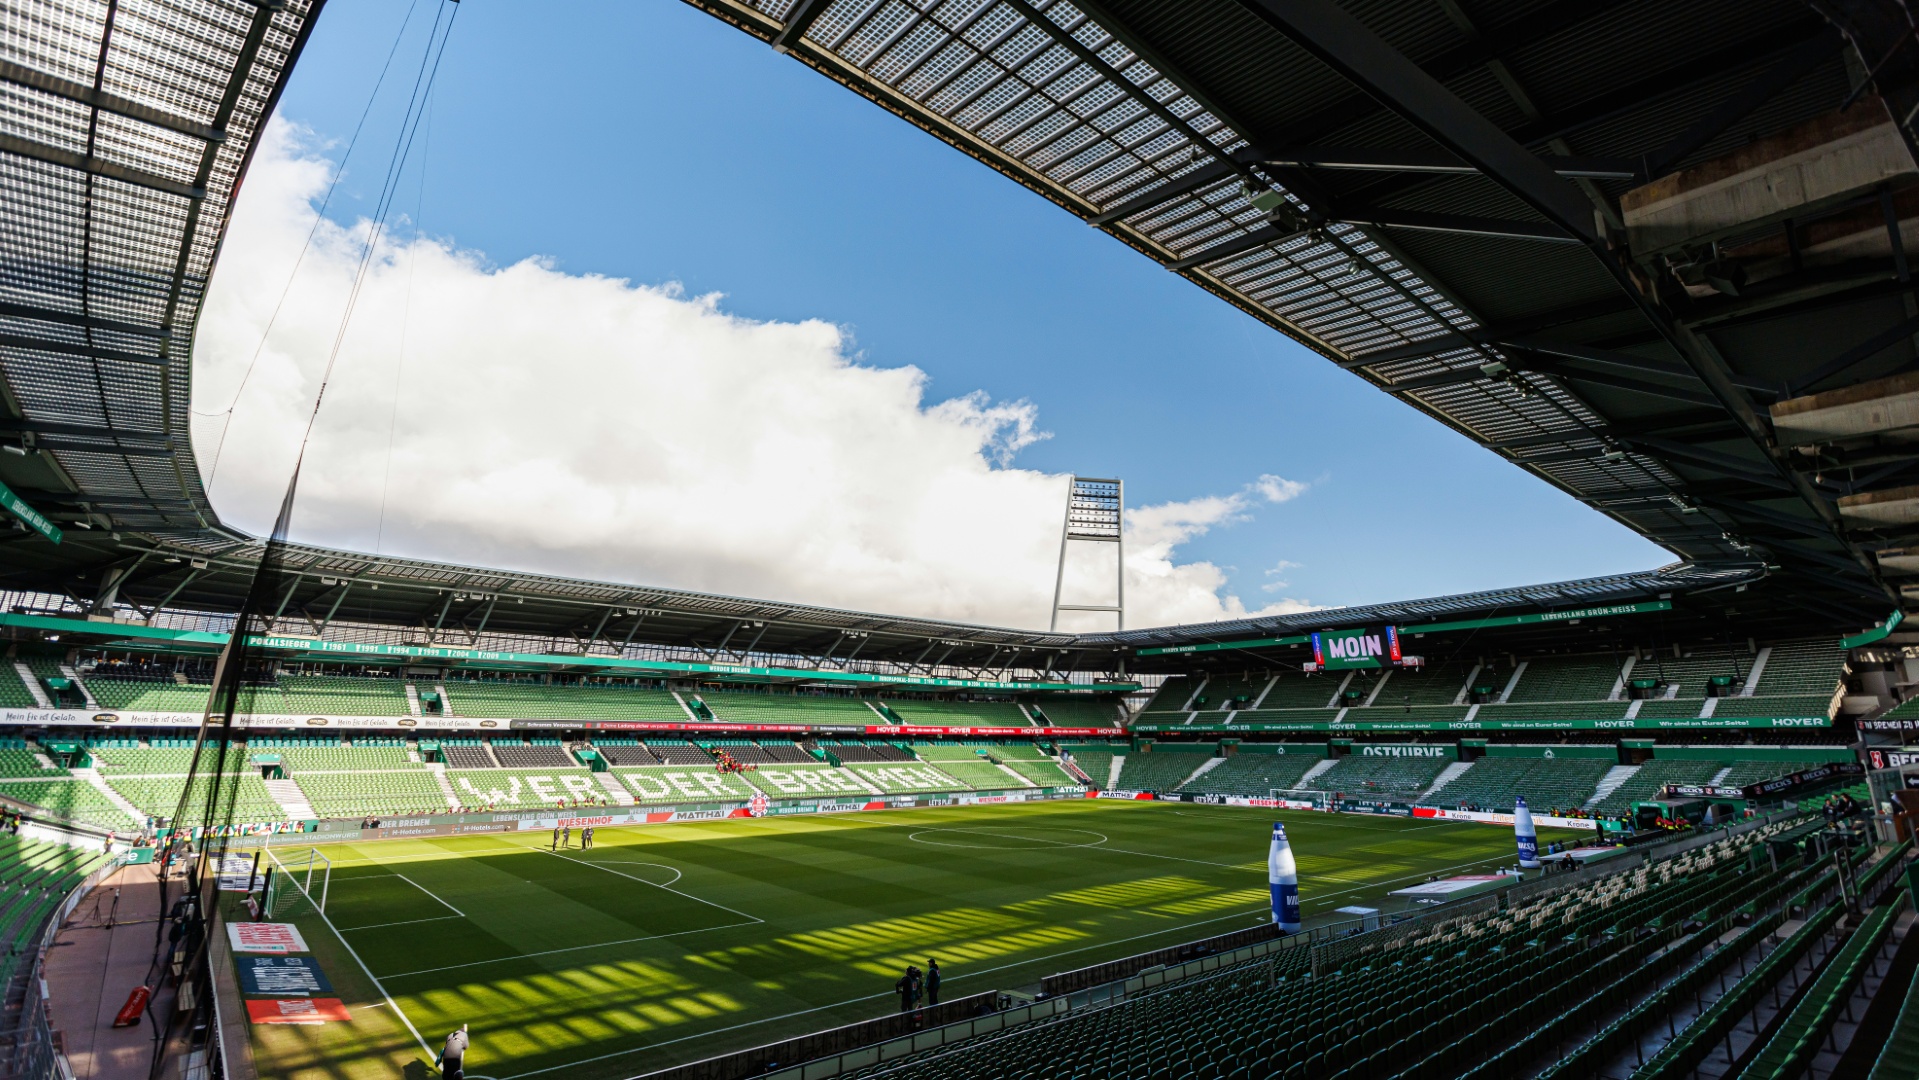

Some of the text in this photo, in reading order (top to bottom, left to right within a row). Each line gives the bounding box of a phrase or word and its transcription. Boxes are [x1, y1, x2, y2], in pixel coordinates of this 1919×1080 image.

[1541, 605, 1636, 620] LEBENSLANG GRÜN-WEISS
[250, 638, 310, 649] POKALSIEGER
[1328, 635, 1382, 658] MOIN
[6, 712, 24, 721] Mein
[27, 712, 37, 721] Eis
[40, 712, 49, 720] ist
[1772, 718, 1823, 726] HOYER
[1363, 747, 1443, 757] OSTKURVE
[1764, 768, 1830, 792] BECK'S BECK'S
[493, 811, 577, 822] LEBENSLANG GRÜN-WEISS
[558, 816, 613, 827] WIESENHOF
[399, 819, 430, 828] BREMEN
